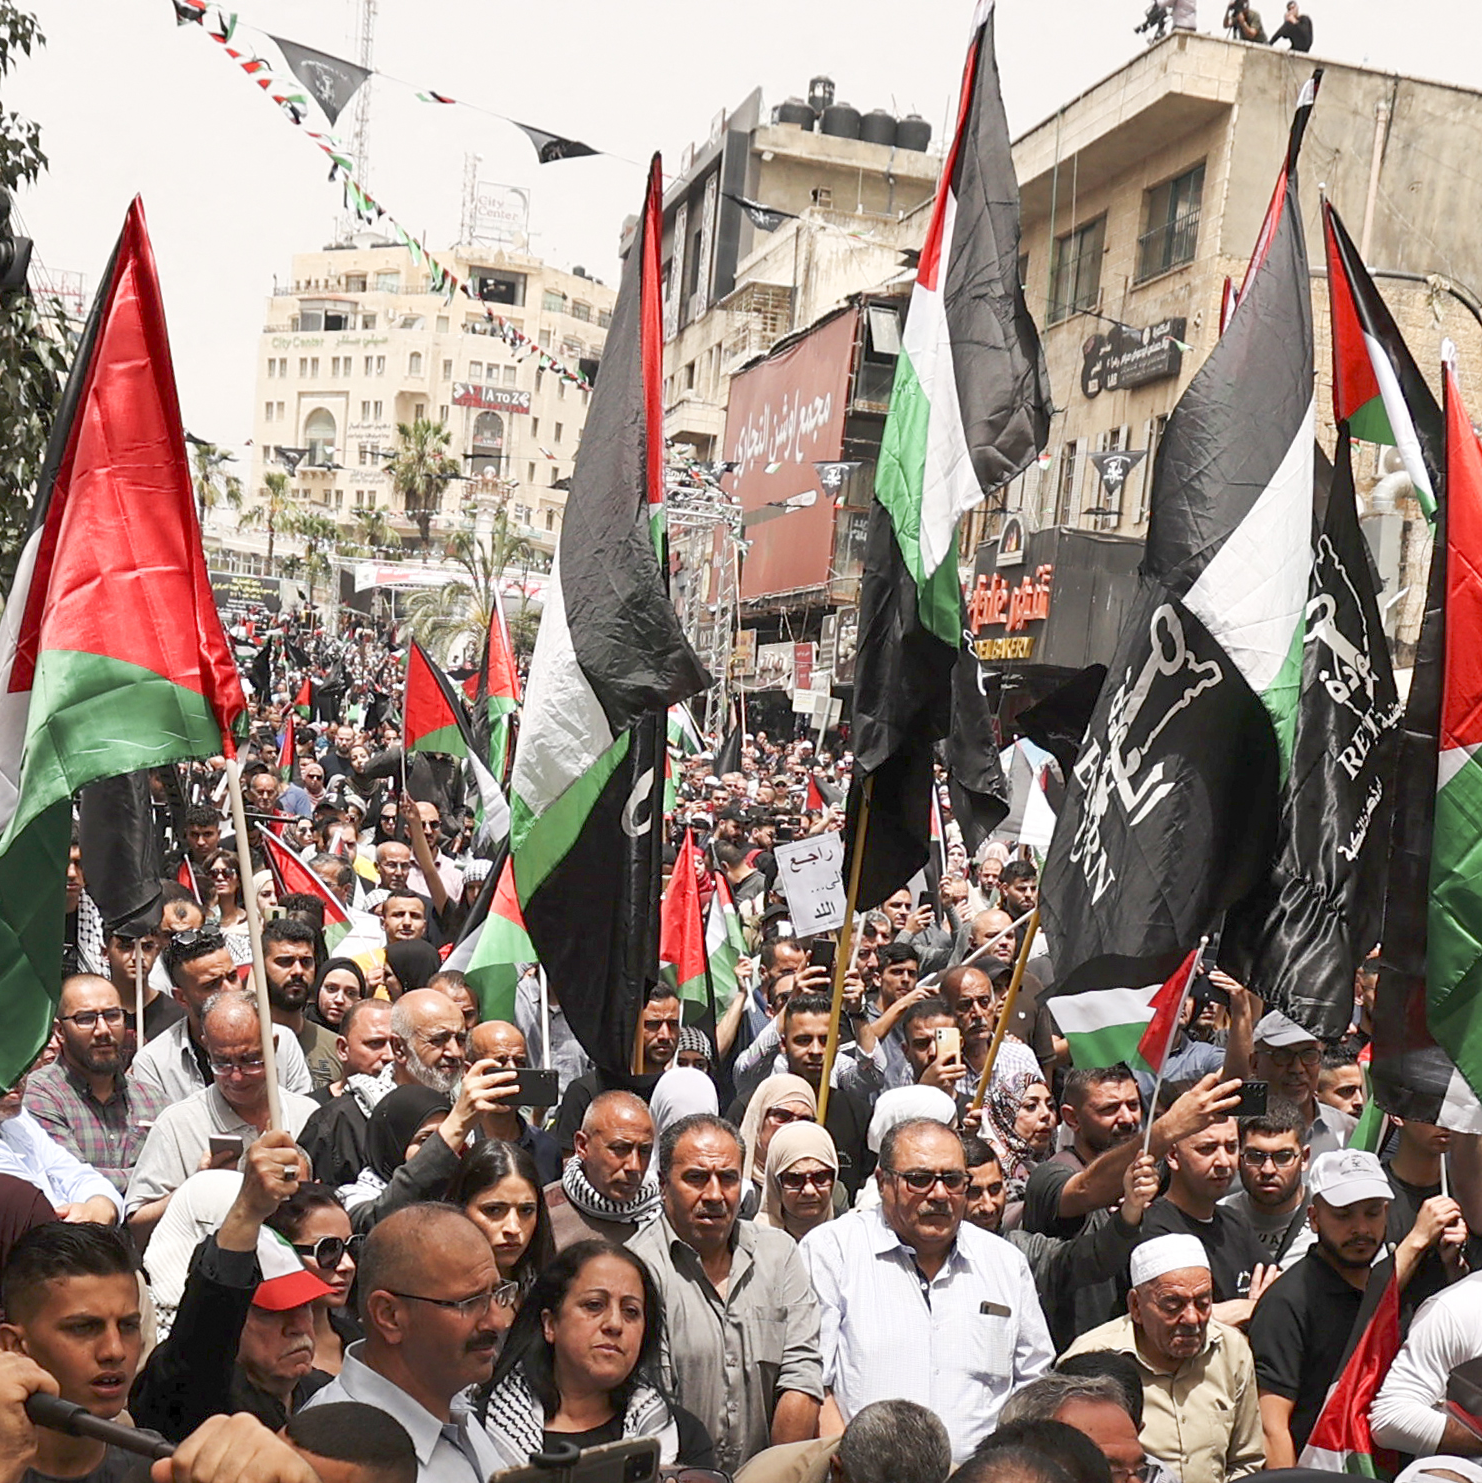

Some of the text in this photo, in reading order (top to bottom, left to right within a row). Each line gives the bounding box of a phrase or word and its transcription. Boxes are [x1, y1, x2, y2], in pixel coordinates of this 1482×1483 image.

[478, 195, 504, 209] City
[478, 206, 518, 221] Center
[272, 336, 325, 351] City Center
[486, 388, 520, 405] A TO Z
[796, 391, 831, 464] مجمع
[732, 403, 770, 490] التجاري
[789, 846, 834, 873] راجع
